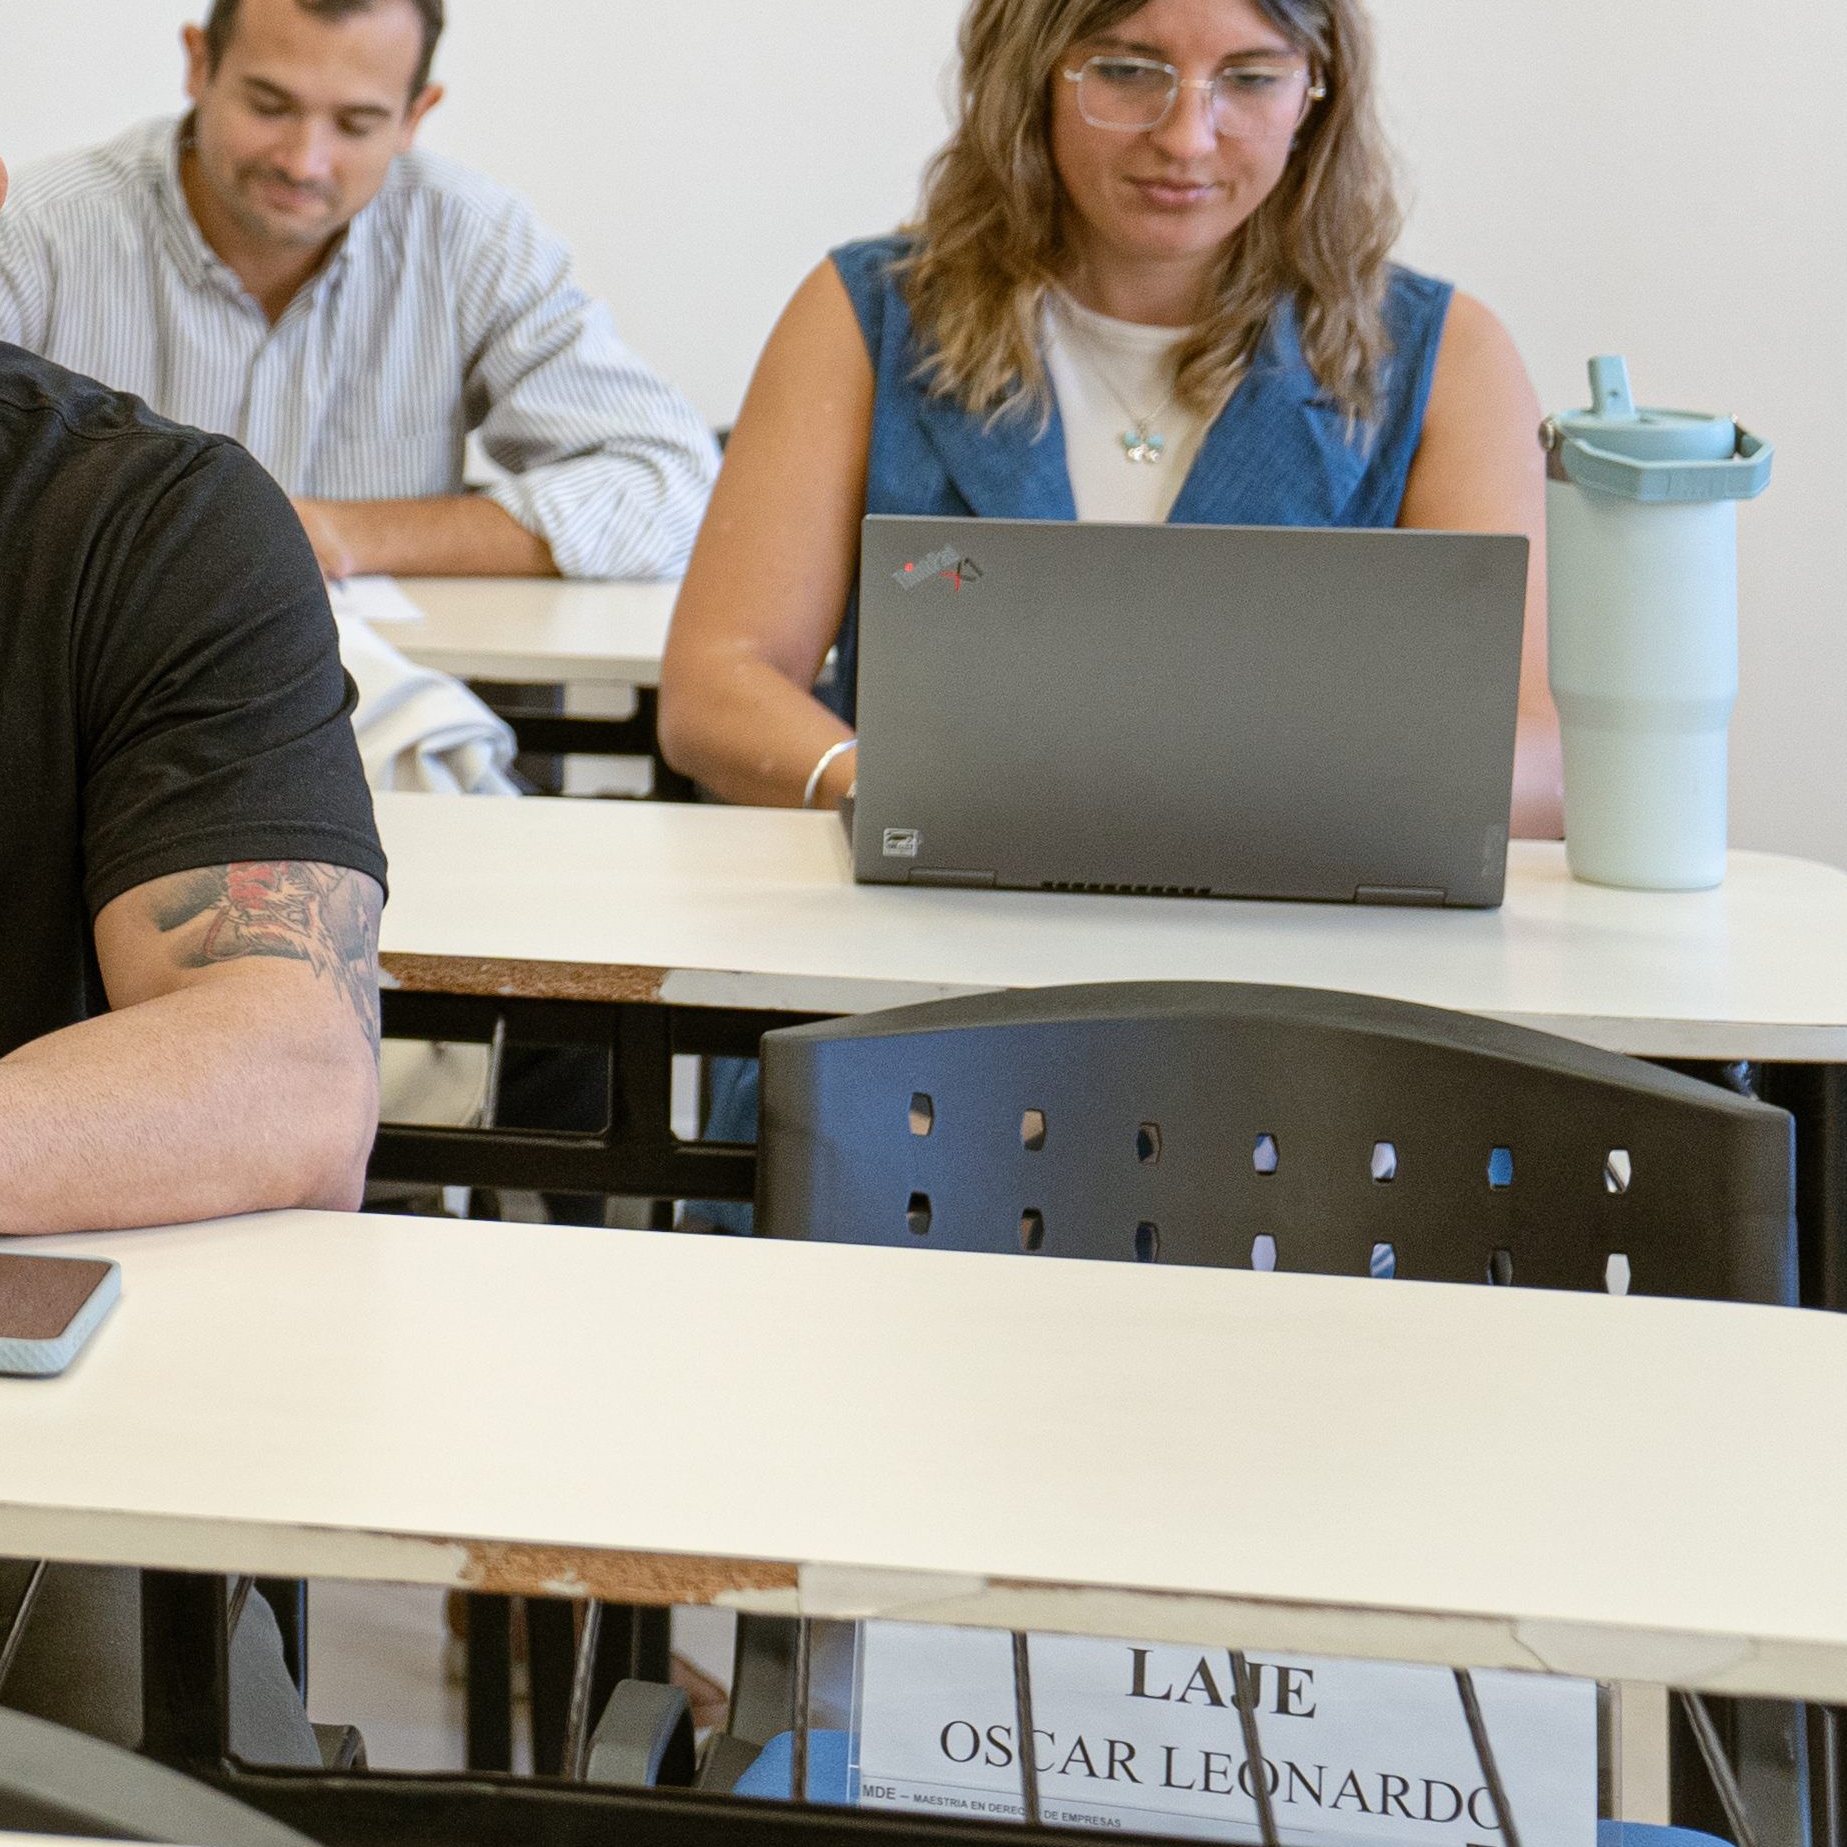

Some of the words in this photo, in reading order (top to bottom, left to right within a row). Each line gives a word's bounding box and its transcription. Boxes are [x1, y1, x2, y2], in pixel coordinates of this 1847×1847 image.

[1124, 1647, 1317, 1719] LAJE
[862, 1784, 897, 1800] MDE
[913, 1794, 968, 1808] MAESTRIA
[971, 1801, 986, 1810] EN
[988, 1803, 1026, 1816] DEREC
[1044, 1810, 1058, 1820] DE
[1062, 1812, 1121, 1828] EMPRESAS
[939, 1719, 1143, 1786] OSCAR
[1159, 1745, 1512, 1830] LEONARDO
